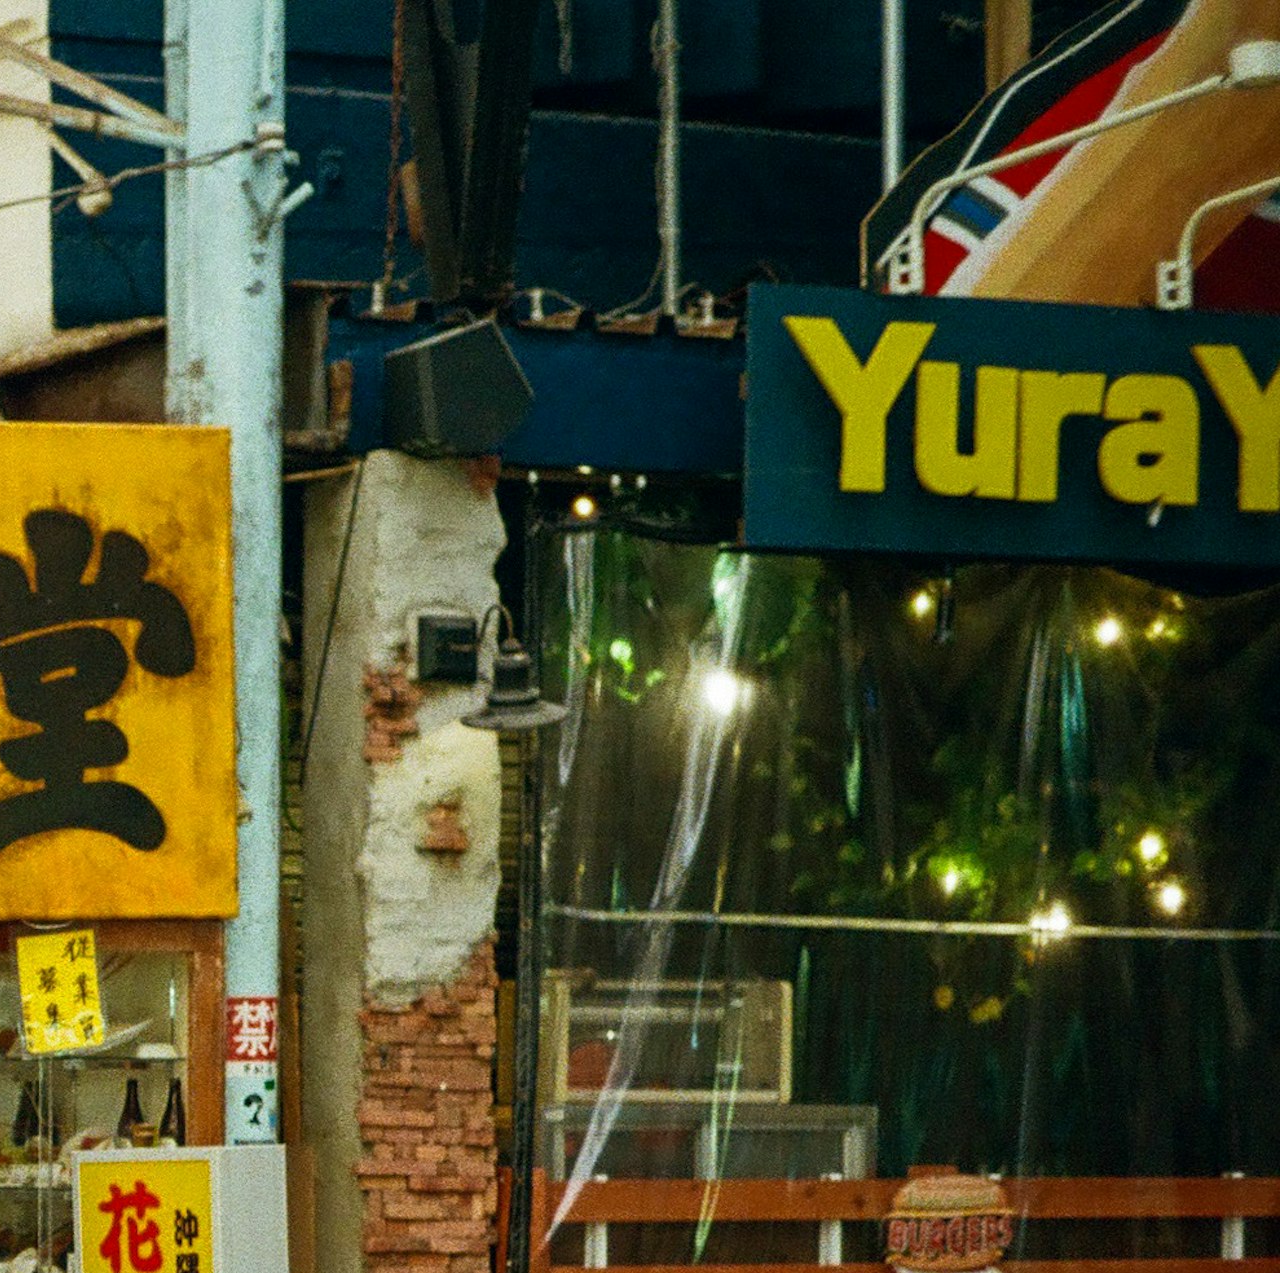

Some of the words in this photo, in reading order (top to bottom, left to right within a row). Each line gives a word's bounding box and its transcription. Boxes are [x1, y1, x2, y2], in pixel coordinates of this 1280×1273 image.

[782, 314, 1280, 516] YuraY
[232, 1000, 278, 1058] 禁
[887, 1214, 1014, 1256] BURGERS
